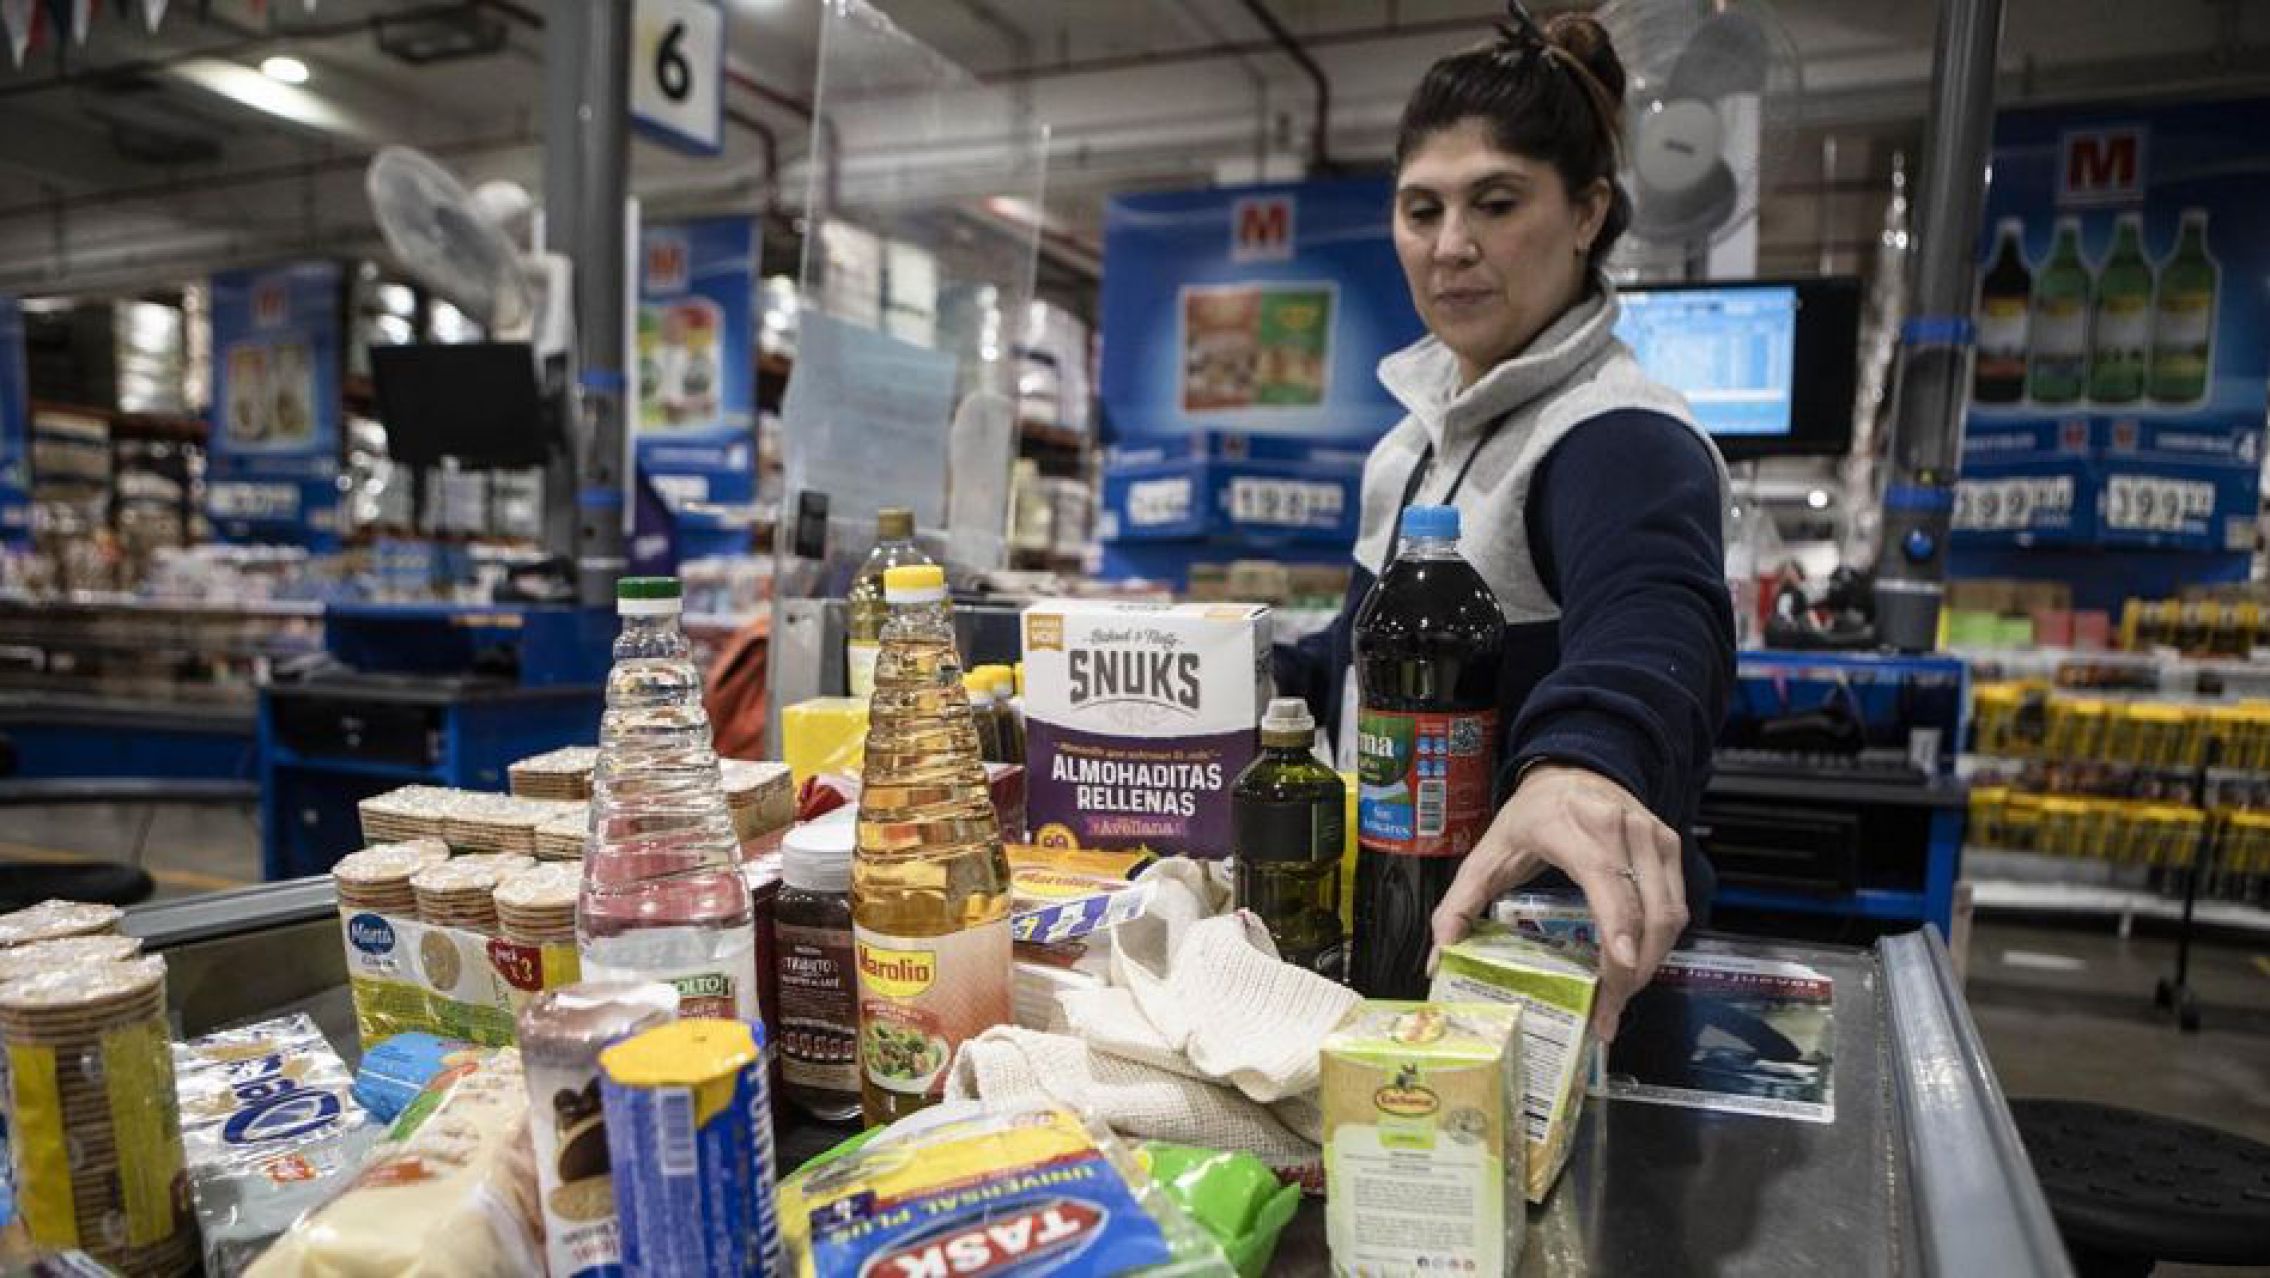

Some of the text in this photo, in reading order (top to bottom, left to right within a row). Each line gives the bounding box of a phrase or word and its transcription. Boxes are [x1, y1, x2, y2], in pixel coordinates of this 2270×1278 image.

[656, 22, 691, 101] 6
[2067, 135, 2138, 192] M
[1240, 200, 1290, 248] M
[1069, 649, 1201, 710] SNUKS
[1052, 753, 1223, 791] ALMOHADITAS
[1077, 785, 1196, 817] RELLENAS
[677, 976, 721, 994] OLTO
[927, 1165, 1096, 1214] UNIVERSAL
[893, 1205, 1081, 1278] TASK
